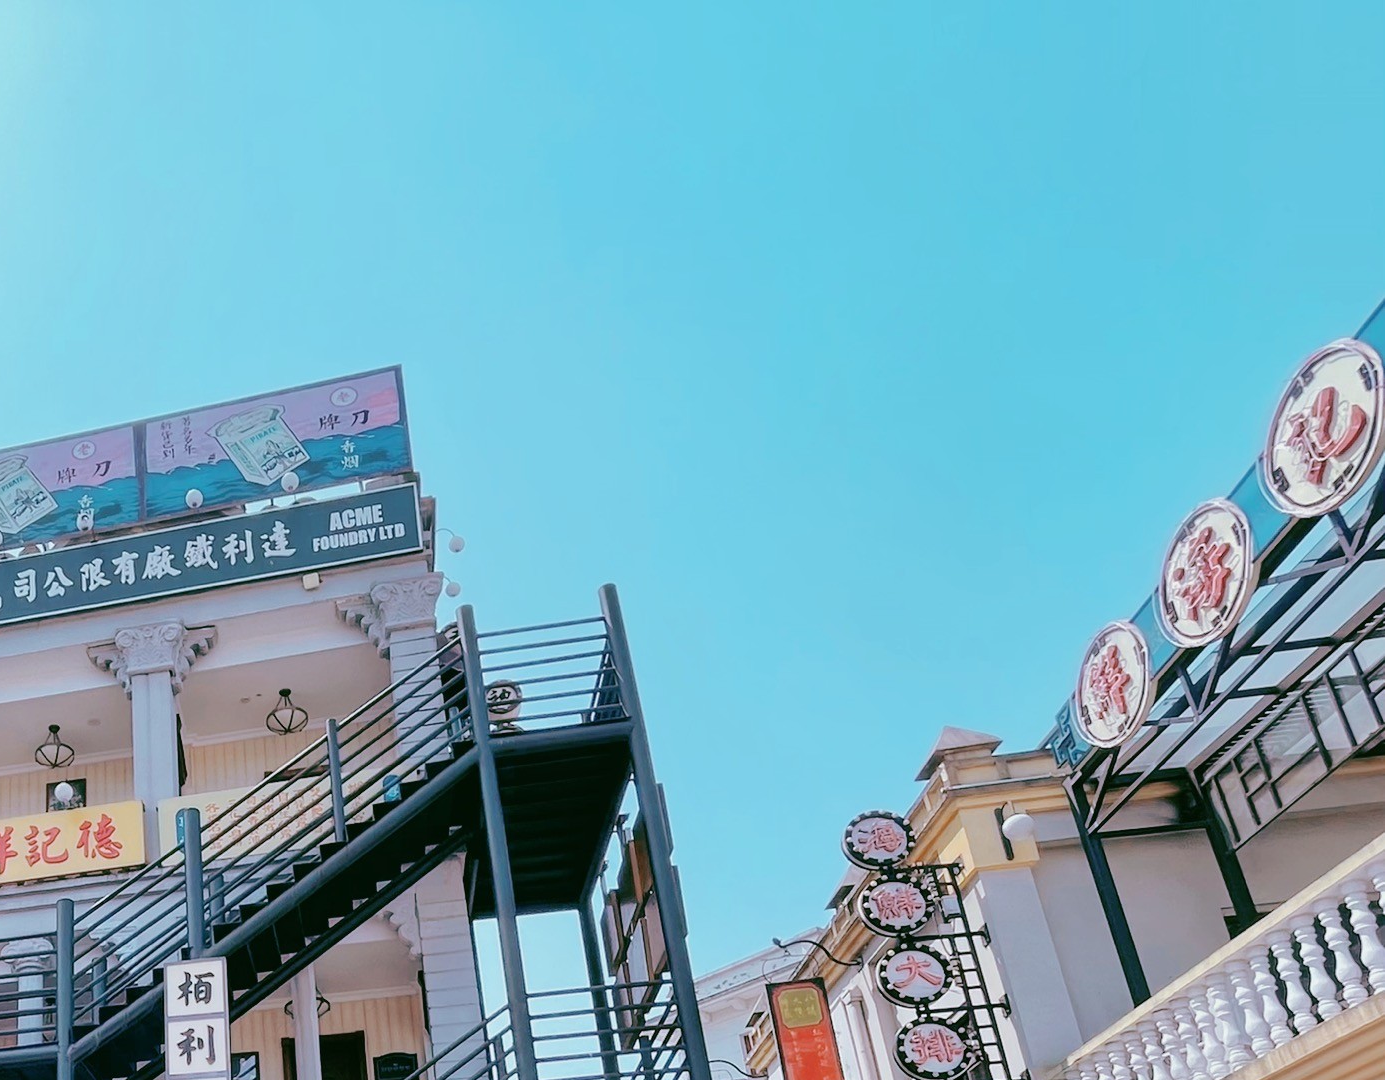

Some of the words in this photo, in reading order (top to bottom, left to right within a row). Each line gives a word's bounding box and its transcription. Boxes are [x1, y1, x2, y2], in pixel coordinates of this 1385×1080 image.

[328, 504, 384, 532] ACME
[312, 528, 378, 554] FOUNDRY
[380, 520, 406, 545] LTD
